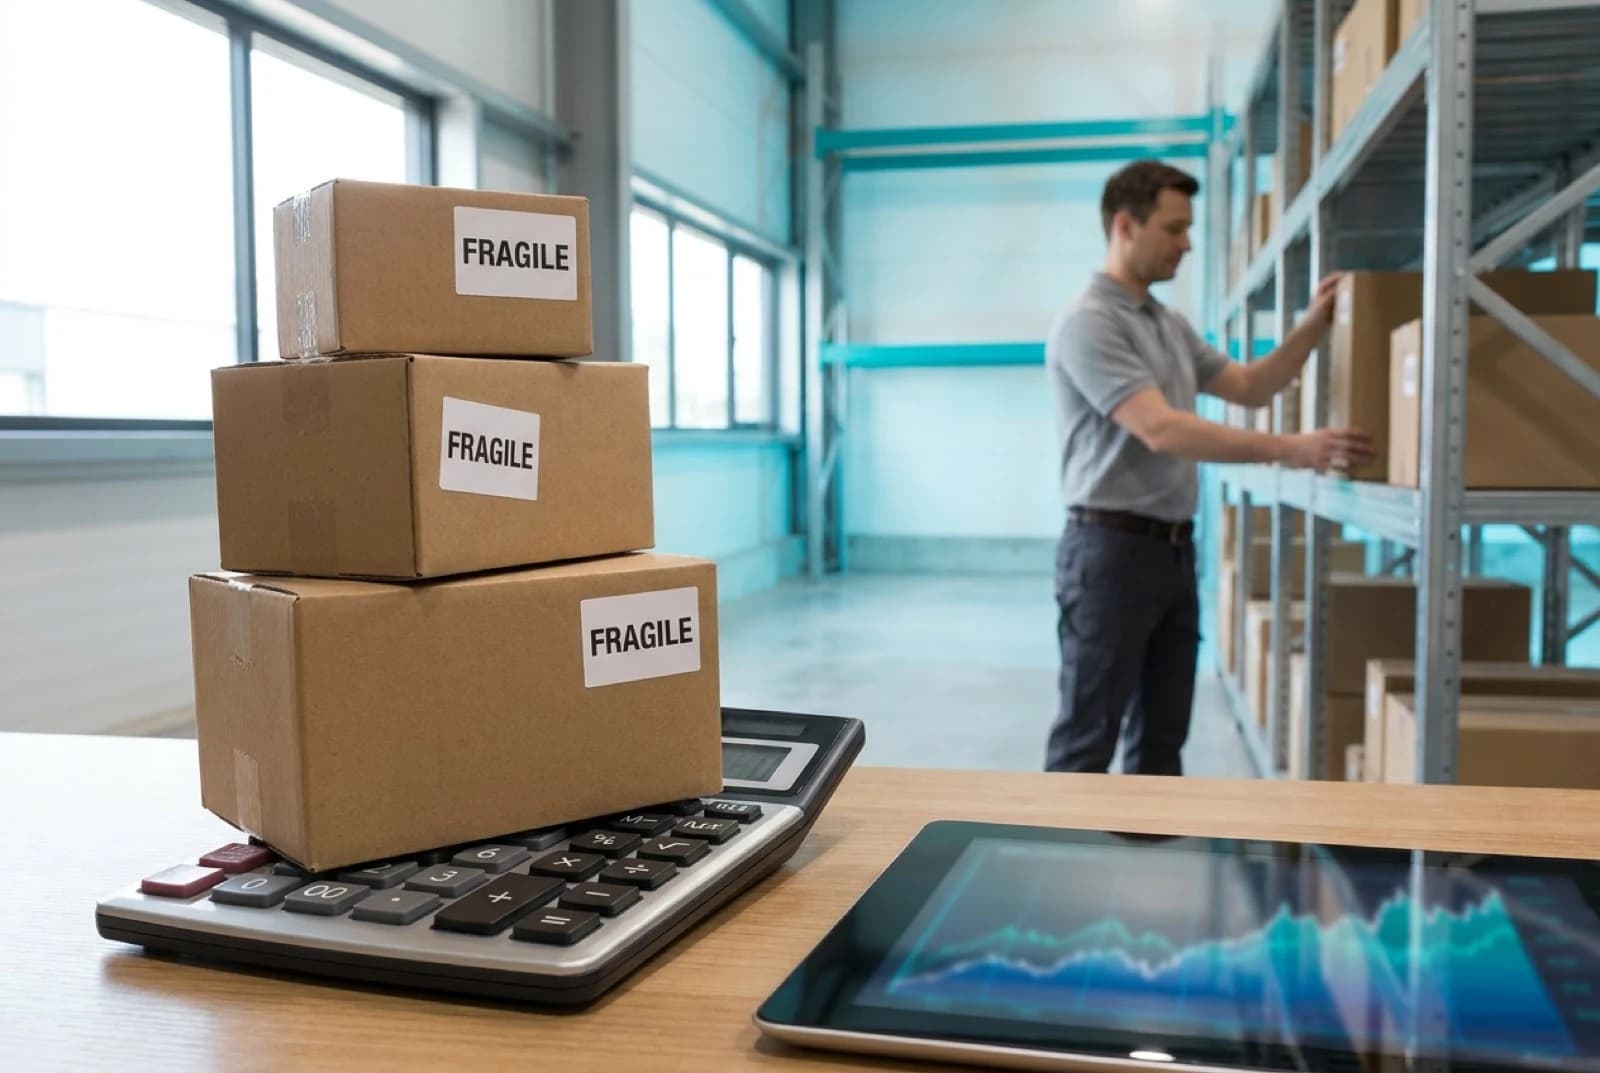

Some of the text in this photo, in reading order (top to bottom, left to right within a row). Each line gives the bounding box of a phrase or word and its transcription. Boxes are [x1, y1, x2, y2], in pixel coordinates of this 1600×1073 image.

[463, 237, 569, 272] FRAGILE
[447, 430, 534, 470] FRAGILE
[590, 615, 693, 657] FRAGILE
[241, 878, 268, 889] 0
[429, 870, 458, 882] 3
[303, 885, 348, 898] 00
